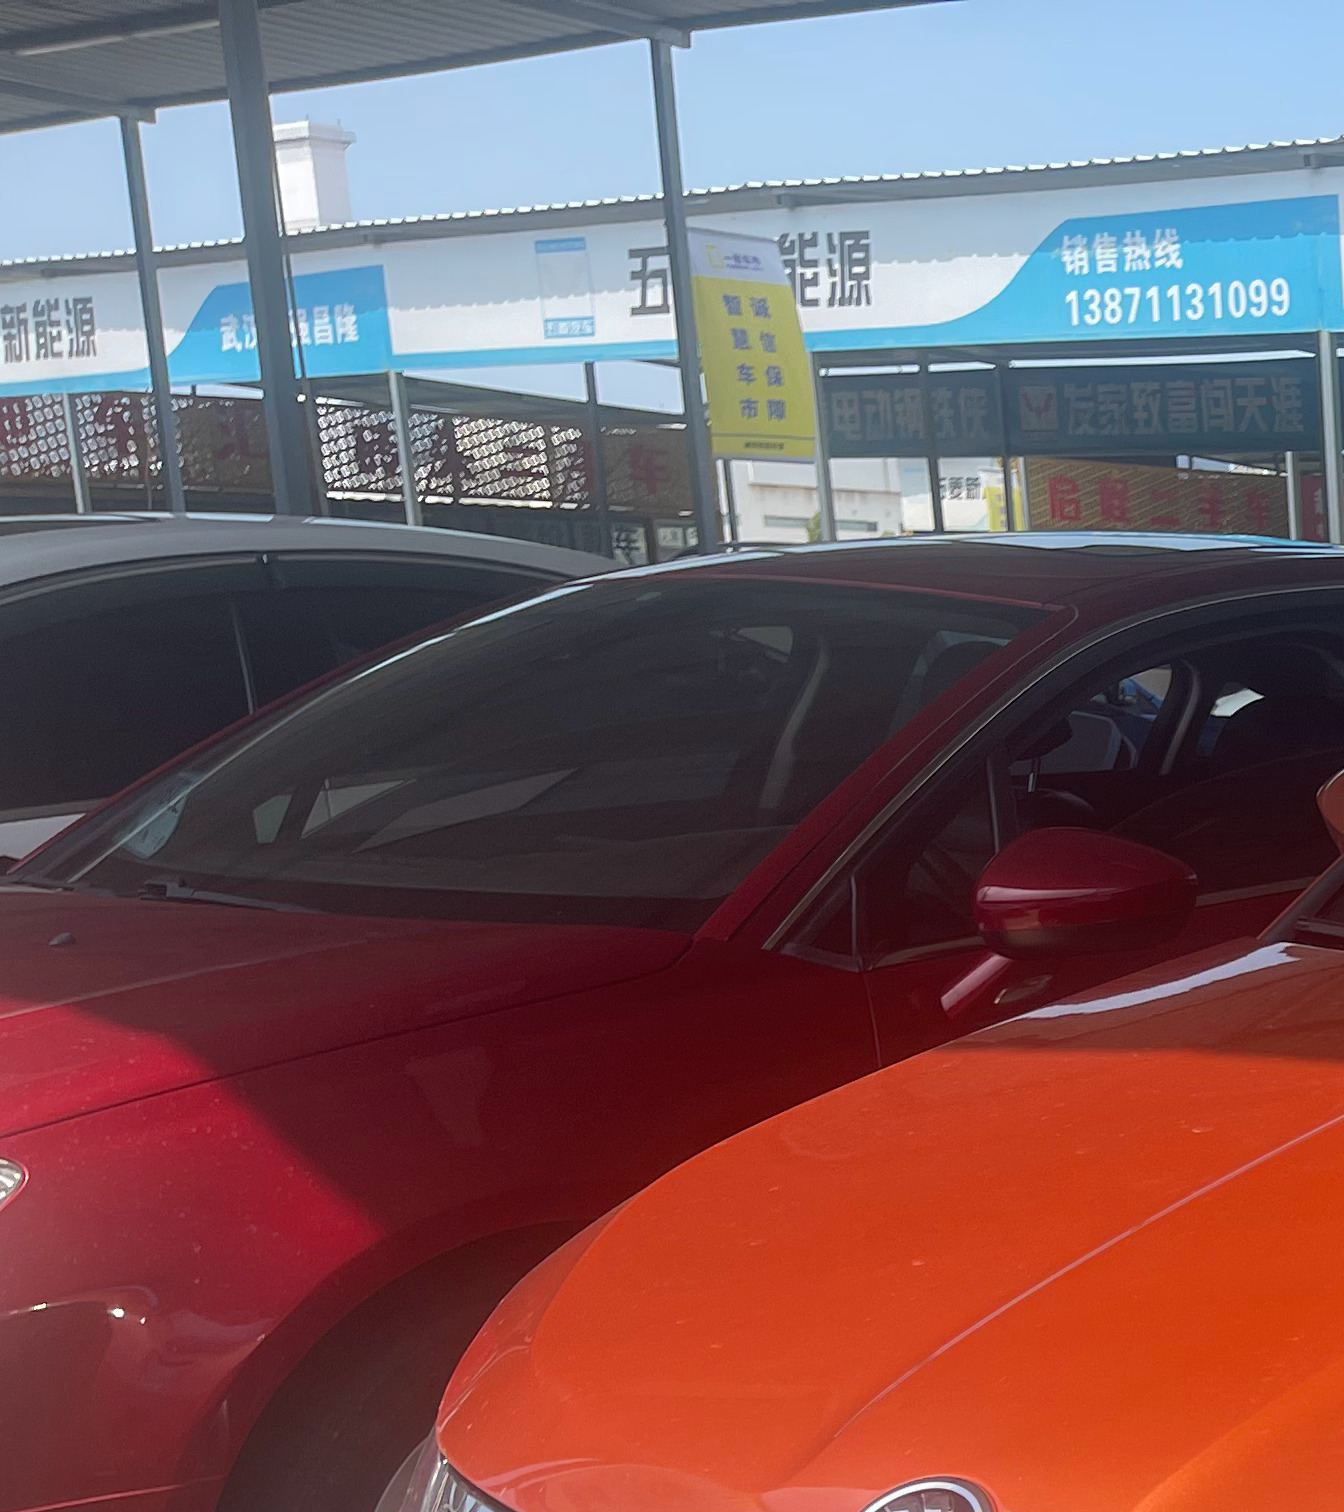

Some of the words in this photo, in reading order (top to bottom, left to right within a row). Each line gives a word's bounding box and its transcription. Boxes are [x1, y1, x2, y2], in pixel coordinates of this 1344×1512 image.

[1062, 227, 1184, 276] 销售热线
[1064, 278, 1291, 328] 13871131099
[1, 296, 97, 364] 新能源
